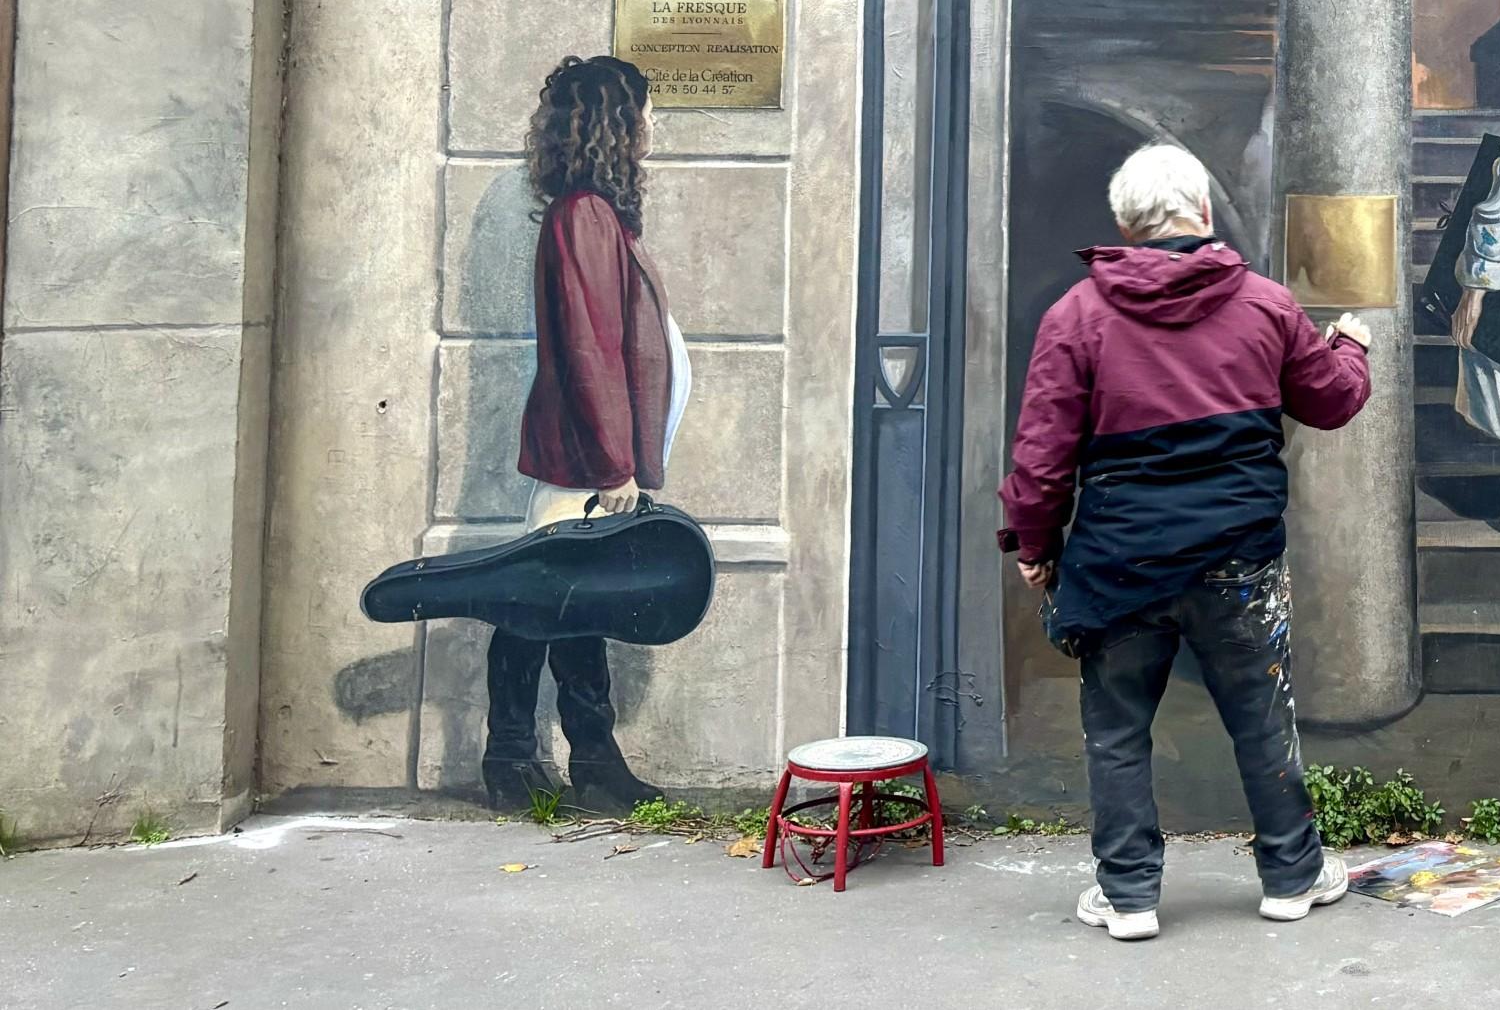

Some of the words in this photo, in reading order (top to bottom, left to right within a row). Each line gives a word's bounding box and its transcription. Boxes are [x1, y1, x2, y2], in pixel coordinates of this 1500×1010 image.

[652, 2, 671, 13] LA
[677, 2, 747, 15] FRESQUE
[652, 16, 676, 24] DES
[682, 16, 744, 25] LYONNAIS
[630, 44, 700, 54] CONCEPTION
[645, 68, 670, 82] Cité
[672, 69, 687, 82] de
[688, 69, 699, 82] la
[701, 68, 753, 83] Création
[665, 84, 678, 95] 78
[682, 84, 698, 95] 50
[702, 84, 716, 95] 44
[722, 85, 736, 95] 57
